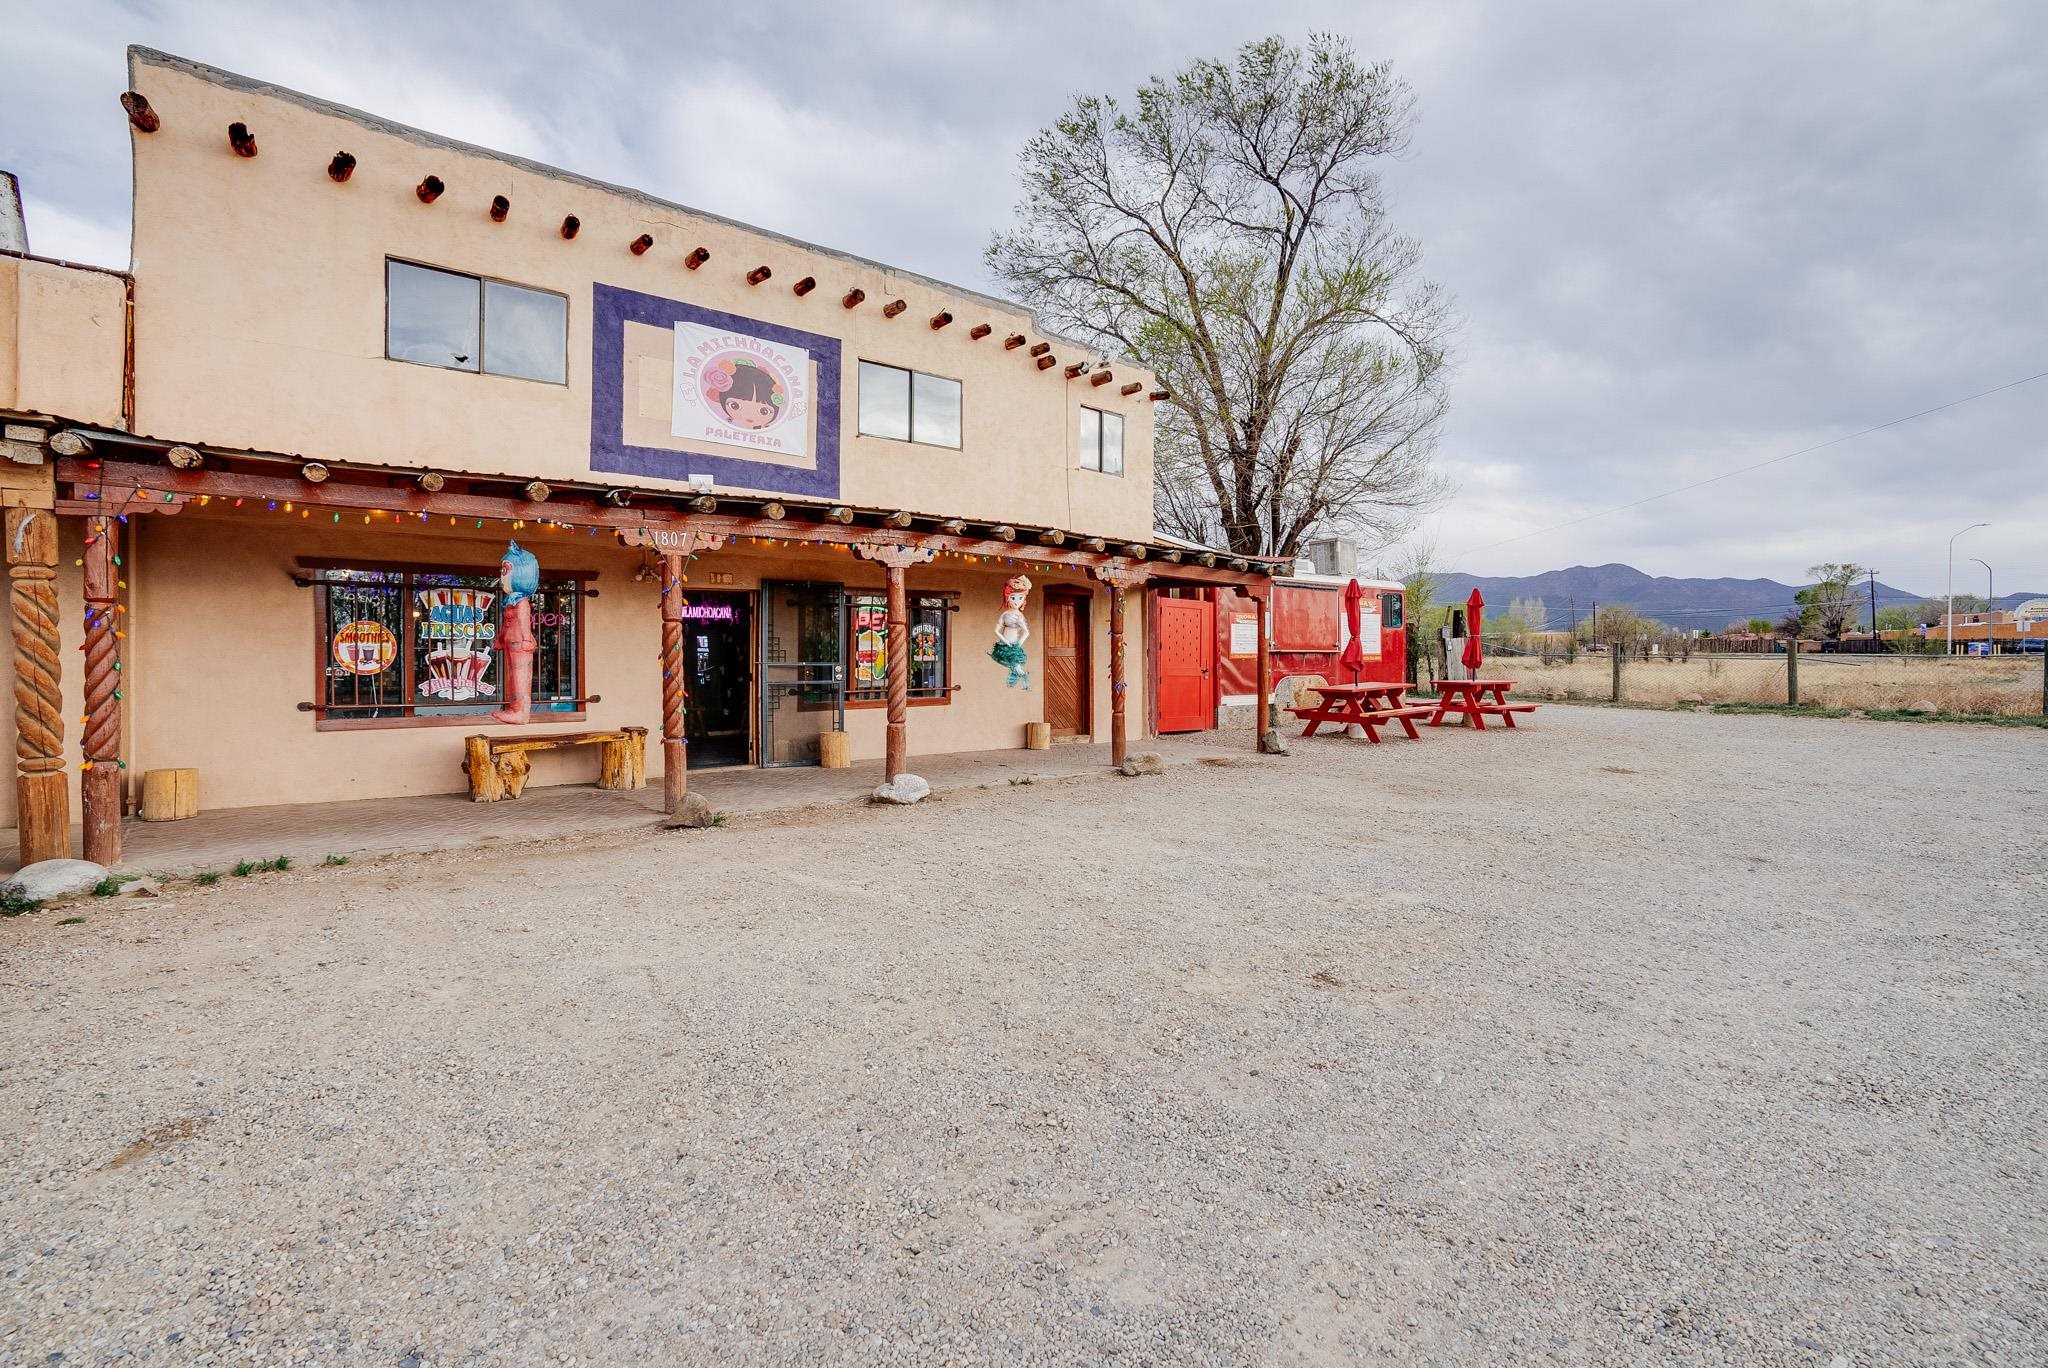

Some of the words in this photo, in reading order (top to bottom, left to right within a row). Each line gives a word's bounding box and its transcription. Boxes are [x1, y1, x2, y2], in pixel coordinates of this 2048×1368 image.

[683, 355, 700, 380] LA
[696, 336, 804, 398] MICHOACANA
[705, 427, 782, 448] PALETERIA
[654, 531, 687, 547] 1807
[347, 593, 372, 603] OEN
[431, 605, 484, 623] AGUAS
[530, 612, 566, 630] pen
[340, 632, 391, 644] SMOOTHIES
[423, 622, 495, 639] FRESCAS
